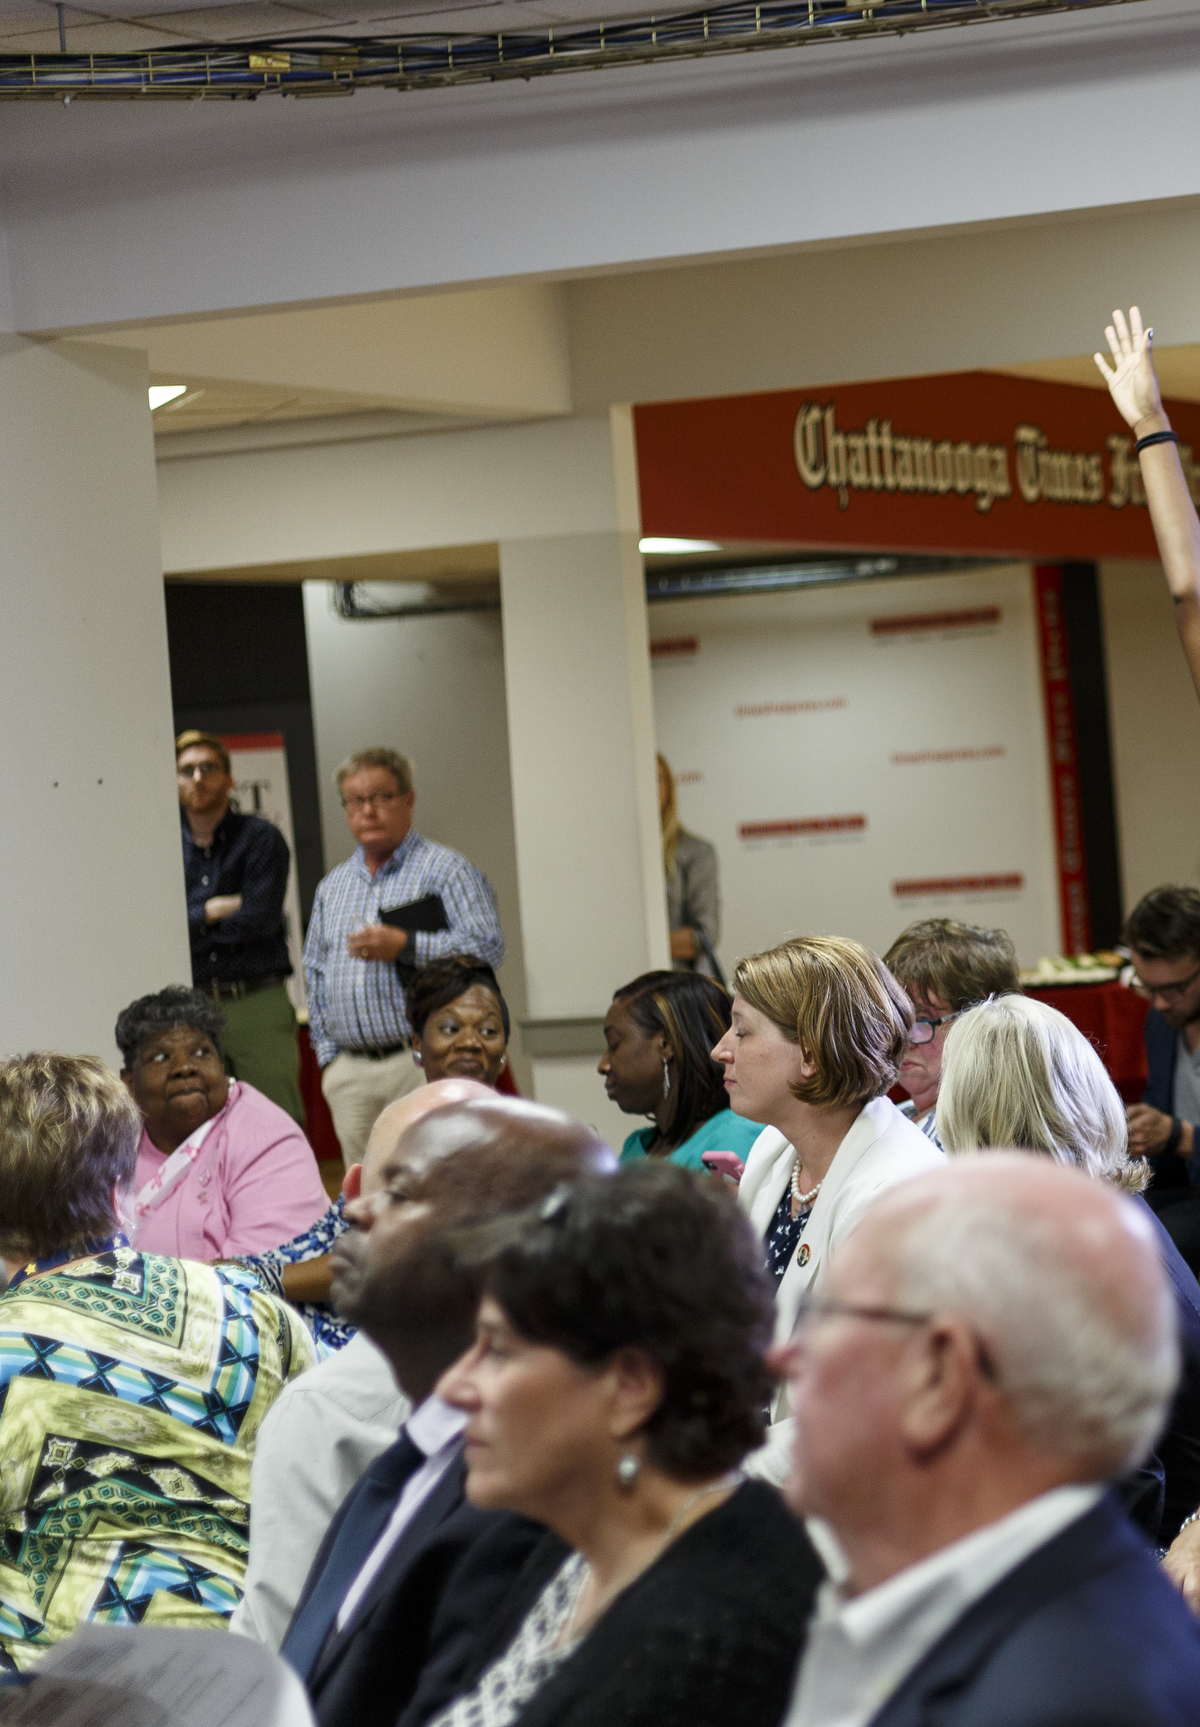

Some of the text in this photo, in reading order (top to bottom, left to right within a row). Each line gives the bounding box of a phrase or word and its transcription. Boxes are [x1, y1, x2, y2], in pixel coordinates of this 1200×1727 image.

[793, 398, 1011, 514] Chattanooga
[1014, 423, 1104, 504] Times
[1106, 433, 1149, 509] Fr
